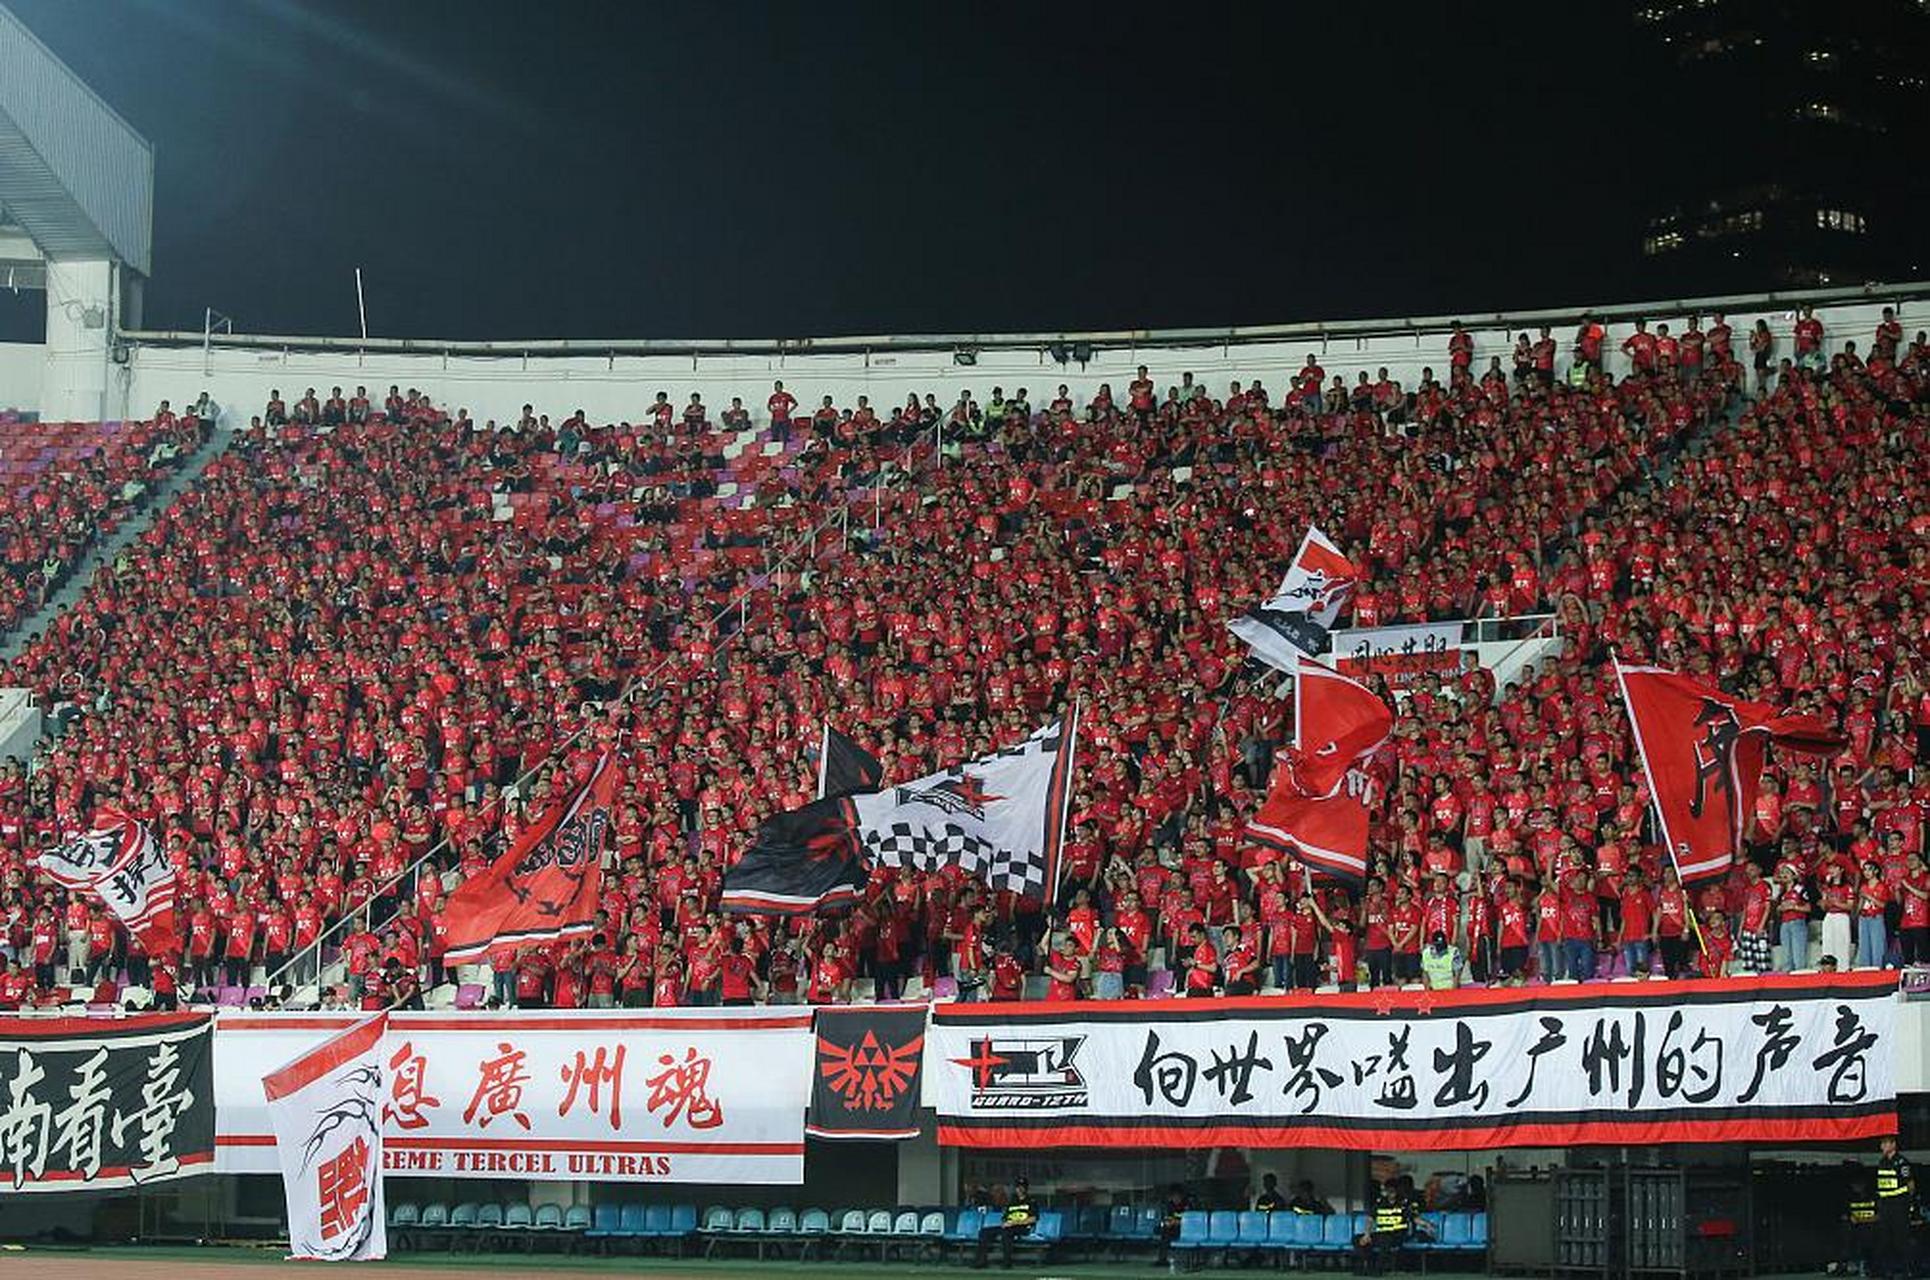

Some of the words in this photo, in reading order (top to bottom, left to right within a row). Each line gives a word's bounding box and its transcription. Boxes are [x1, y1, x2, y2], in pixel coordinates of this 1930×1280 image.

[0, 1041, 194, 1190] 南看臺
[382, 1041, 724, 1130] 息廣州魂
[453, 1152, 556, 1173] TERCEL
[567, 1154, 671, 1175] ULTRAS
